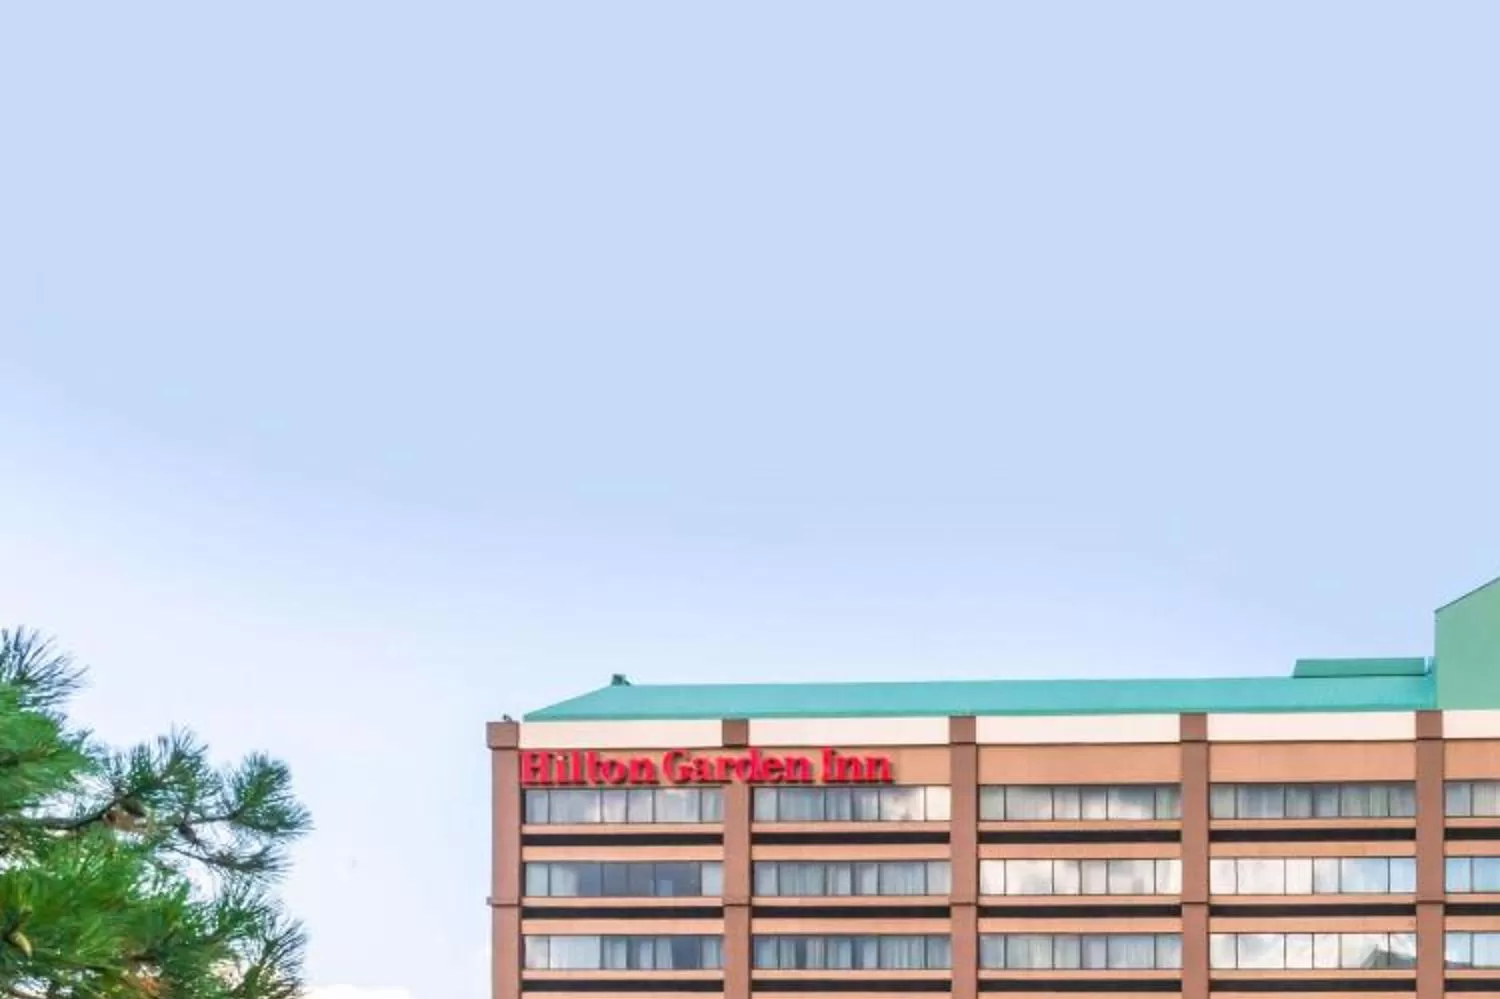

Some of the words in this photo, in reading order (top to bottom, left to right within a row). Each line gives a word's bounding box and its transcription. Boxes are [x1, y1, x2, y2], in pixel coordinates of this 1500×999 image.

[521, 749, 656, 783] Hilton
[662, 748, 811, 783] Garden
[820, 746, 893, 783] Inn
